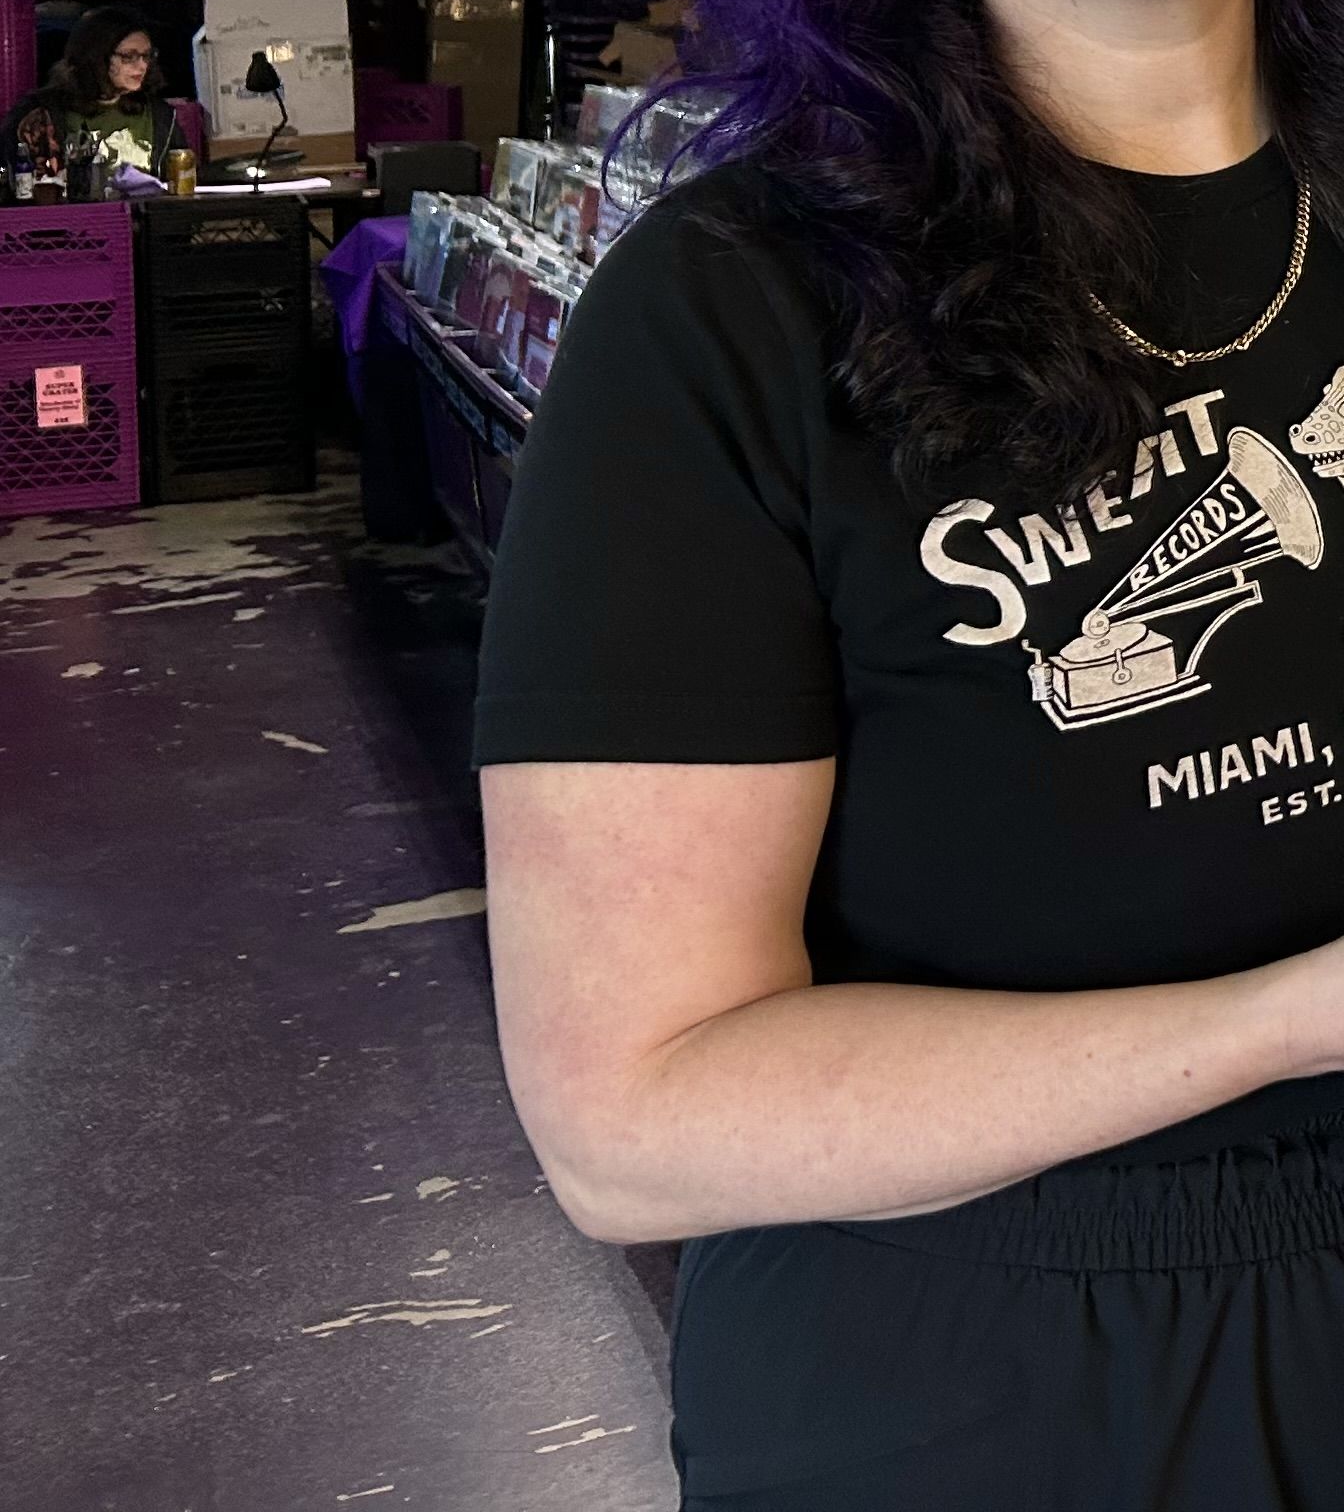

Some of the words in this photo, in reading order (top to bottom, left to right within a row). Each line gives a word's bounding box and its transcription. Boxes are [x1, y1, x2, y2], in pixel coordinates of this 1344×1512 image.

[920, 389, 1225, 645] SWEAT
[1130, 483, 1247, 591] RECORDS
[1148, 722, 1335, 807] MIAMI,
[1261, 777, 1343, 825] EST.
